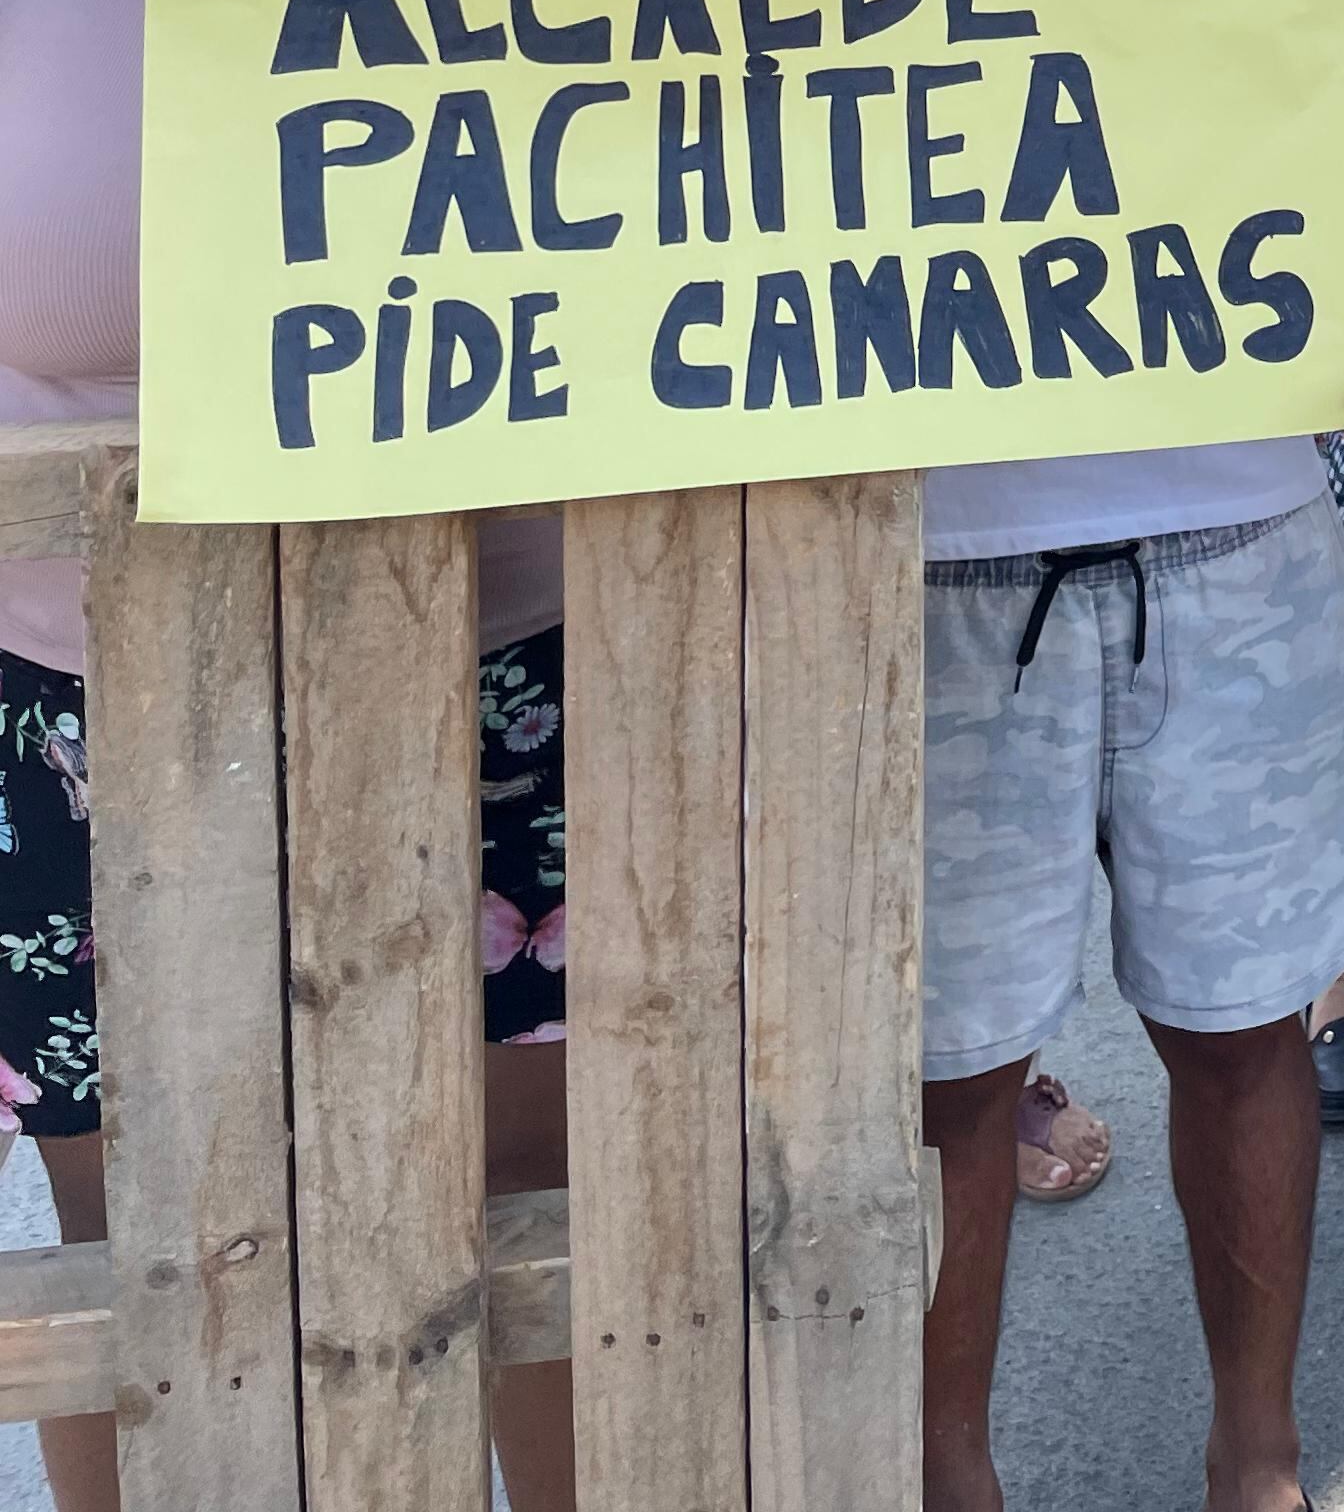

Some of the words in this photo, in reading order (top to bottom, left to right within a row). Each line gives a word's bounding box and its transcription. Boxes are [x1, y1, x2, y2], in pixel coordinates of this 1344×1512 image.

[276, 53, 1119, 265] PACHITEA
[272, 276, 568, 449] PIDE
[651, 210, 1314, 410] CAMARAS
